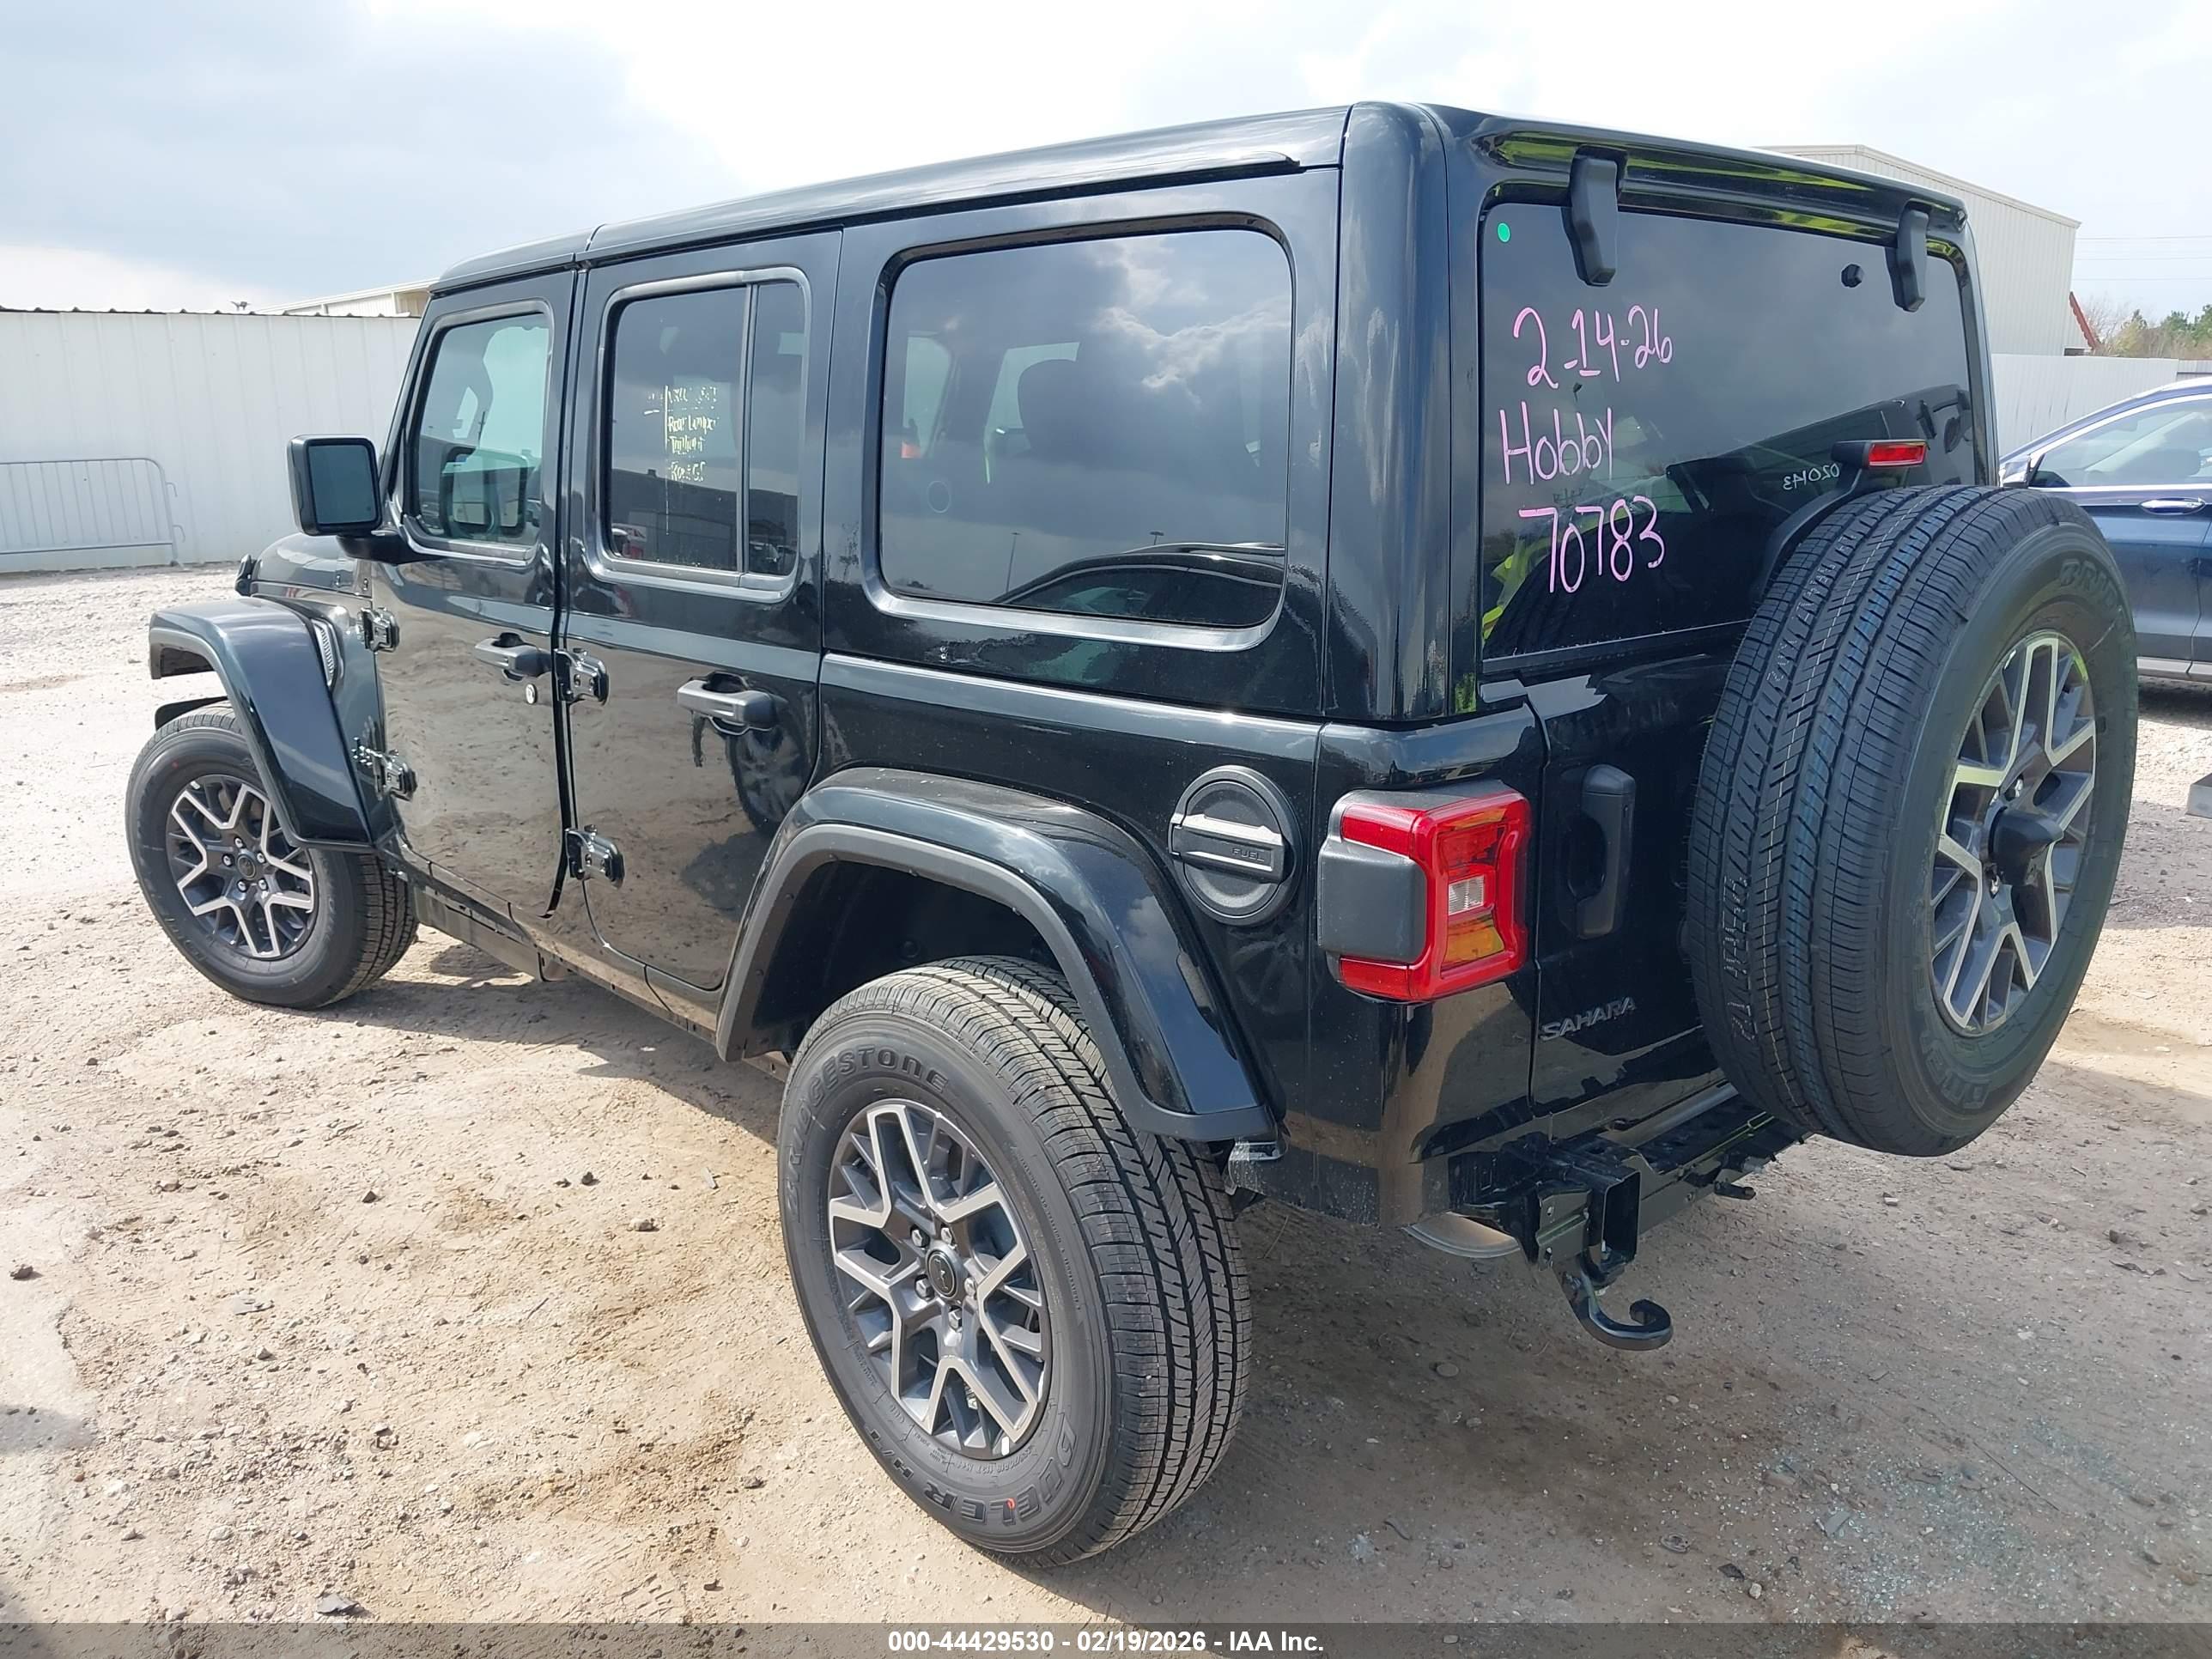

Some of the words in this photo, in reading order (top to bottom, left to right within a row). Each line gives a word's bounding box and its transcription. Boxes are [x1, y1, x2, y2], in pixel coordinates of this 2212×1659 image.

[1513, 305, 1673, 389] 2-14-26
[1499, 401, 1614, 485] Hobby
[1519, 495, 1666, 593] 70783
[1231, 848, 1265, 862] FUEL
[1540, 997, 1636, 1041] SAHARA
